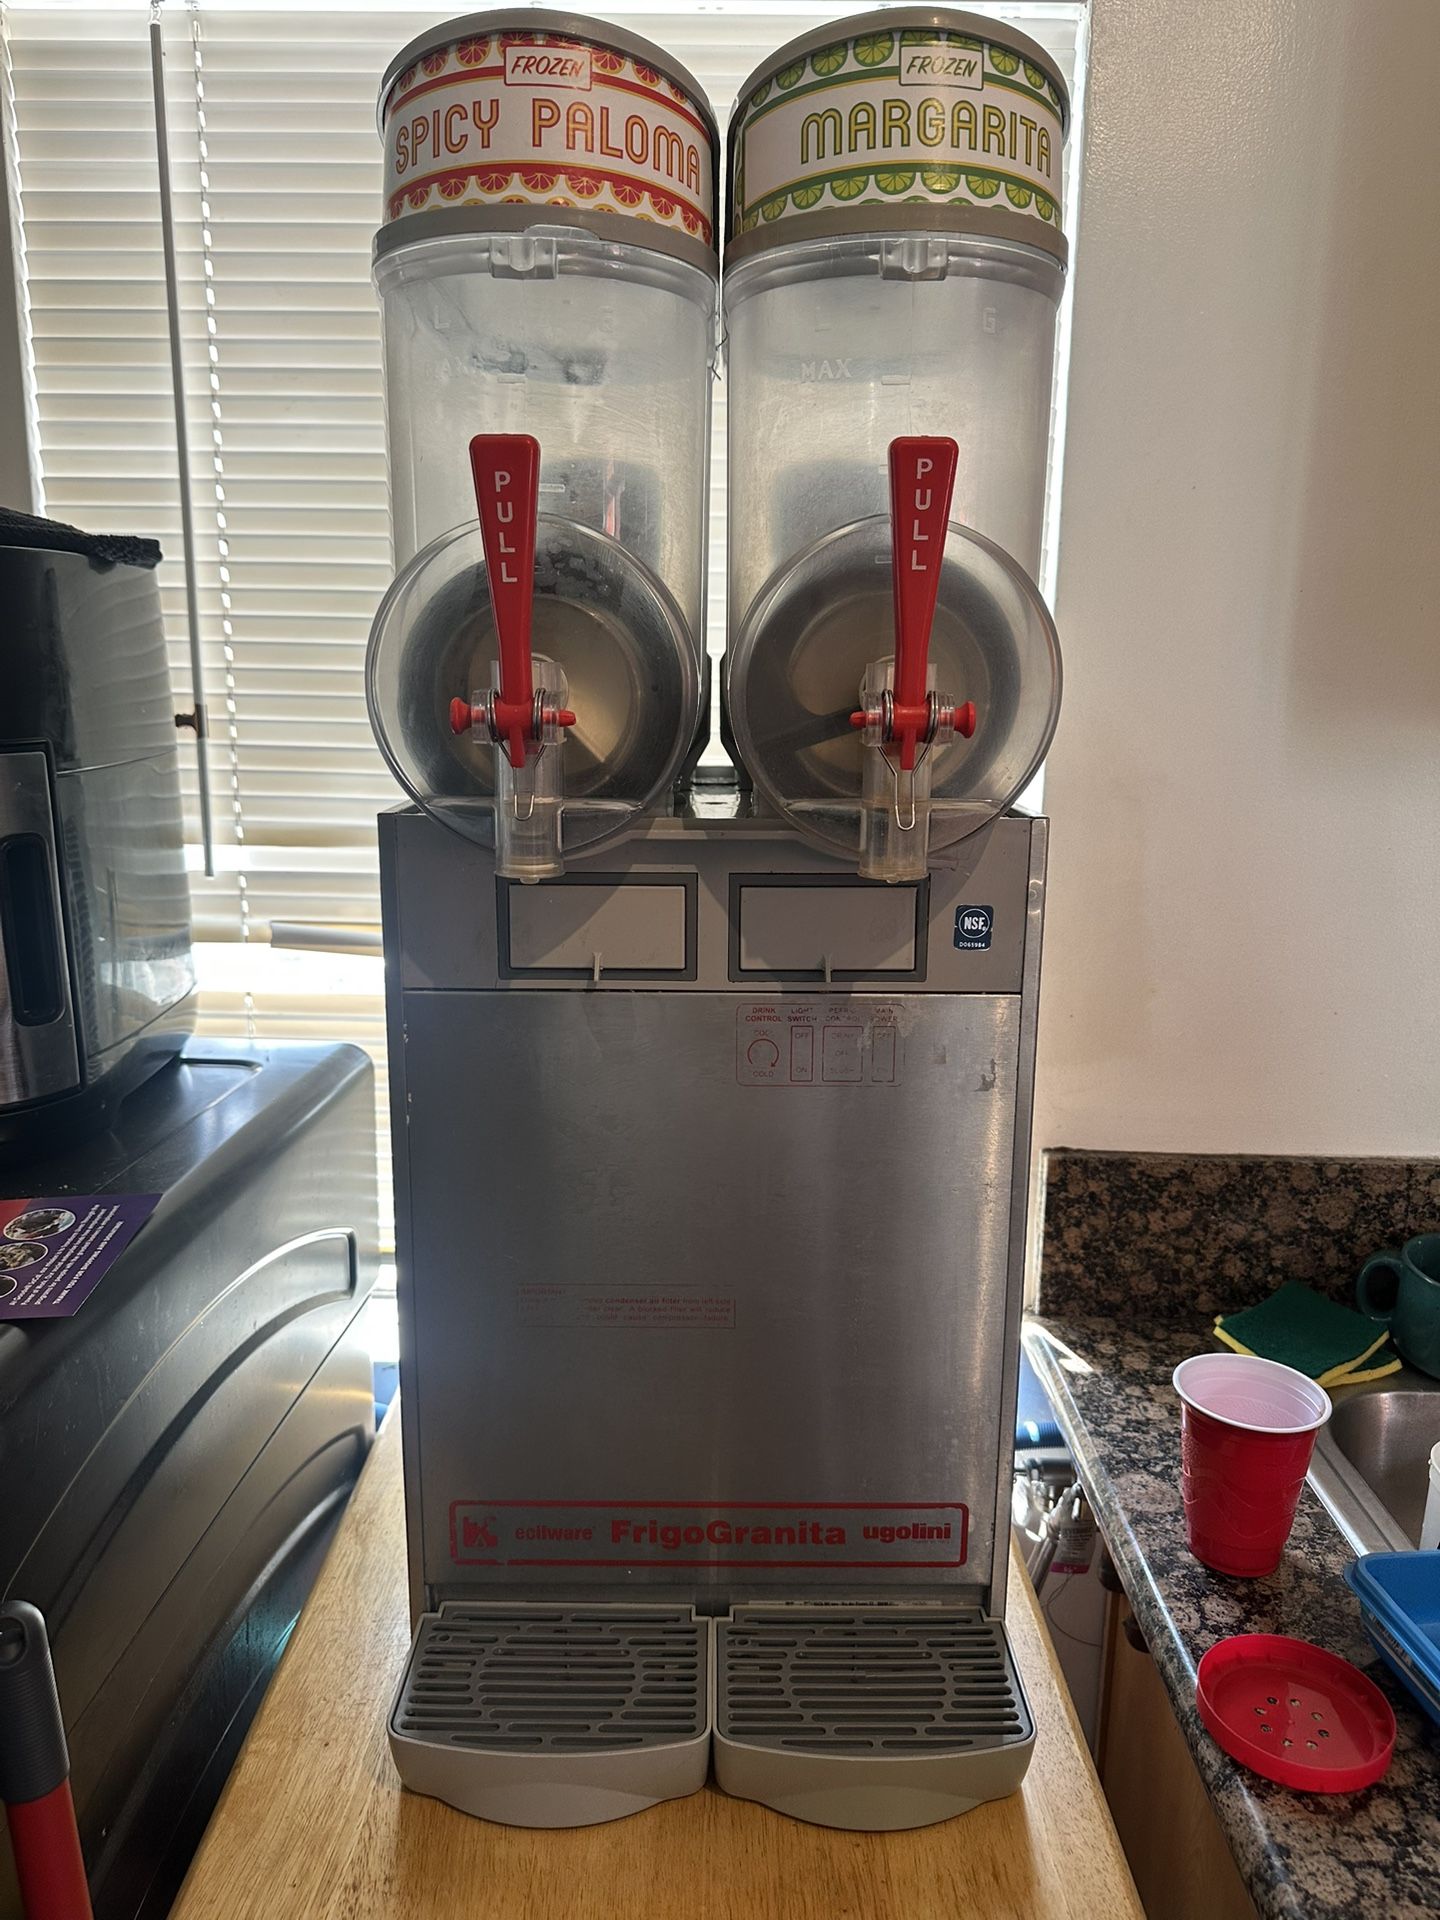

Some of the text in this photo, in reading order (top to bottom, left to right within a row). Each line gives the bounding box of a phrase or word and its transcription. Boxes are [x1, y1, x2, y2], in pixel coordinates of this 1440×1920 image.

[511, 55, 583, 78] FROZEN
[906, 55, 979, 78] FROZEN
[396, 97, 701, 196] SPICY PALOMA
[800, 97, 1051, 178] MARGARITA
[801, 358, 853, 382] MAX
[494, 470, 518, 583] PULL
[911, 458, 934, 571] PULL
[964, 916, 985, 930] NSF
[745, 1015, 783, 1023] CONTROL
[787, 1015, 818, 1023] SWITCH
[611, 1519, 846, 1550] FrigoGranita
[863, 1522, 951, 1544] ugolini
